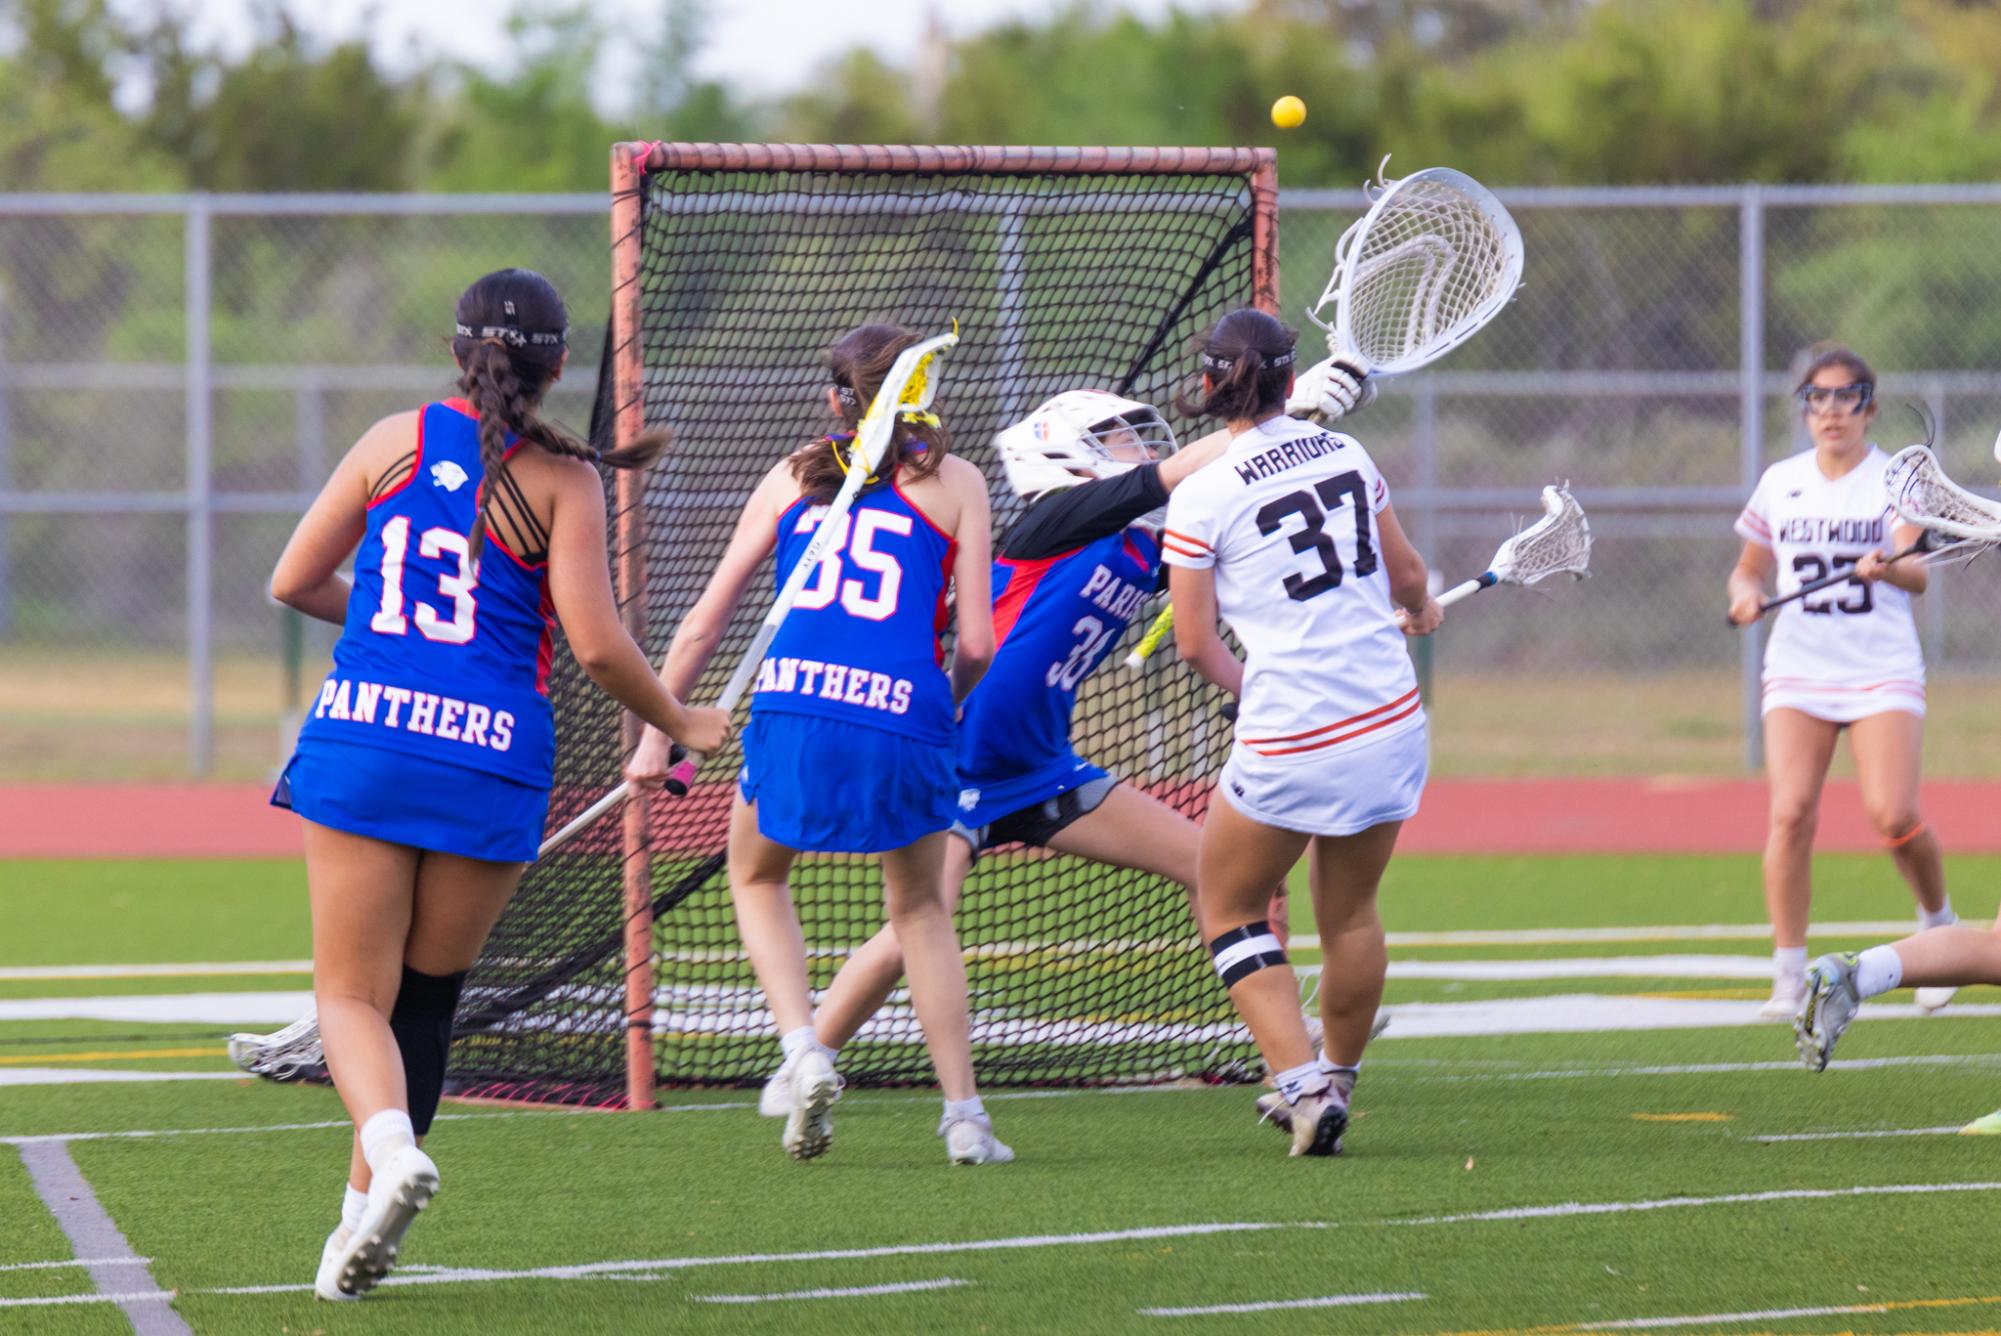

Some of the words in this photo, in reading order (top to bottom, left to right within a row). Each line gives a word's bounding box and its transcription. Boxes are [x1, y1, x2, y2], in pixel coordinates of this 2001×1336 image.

[370, 514, 479, 645] 13
[790, 504, 913, 621] 35
[1255, 469, 1378, 602] 37
[1779, 518, 1883, 544] WESTWOOD
[314, 678, 515, 753] PANTHERS
